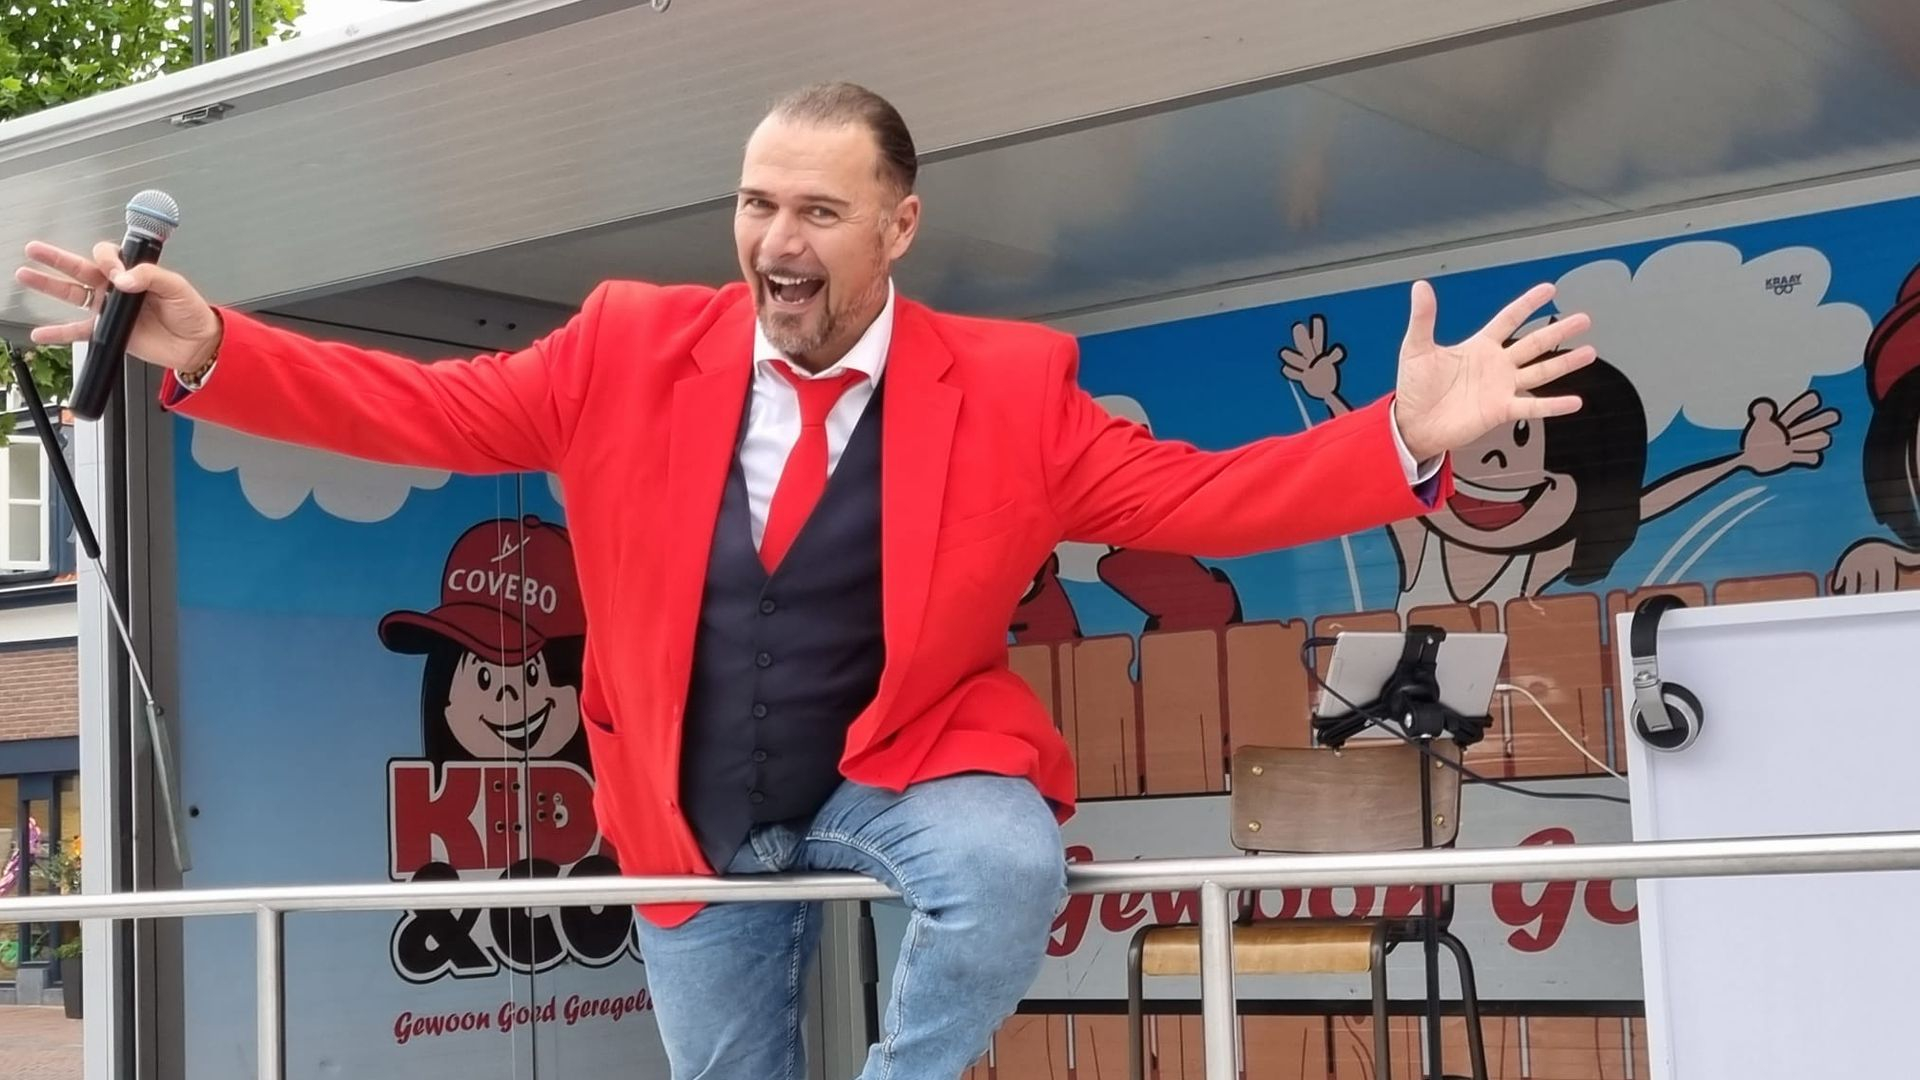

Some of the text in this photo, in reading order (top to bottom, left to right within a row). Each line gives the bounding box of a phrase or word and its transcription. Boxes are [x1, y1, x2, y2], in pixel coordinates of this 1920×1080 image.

[448, 569, 557, 614] COVEBO
[390, 762, 620, 873] KID
[396, 855, 640, 976] &CO
[394, 1011, 490, 1045] Gewoon
[497, 995, 557, 1034] Goed
